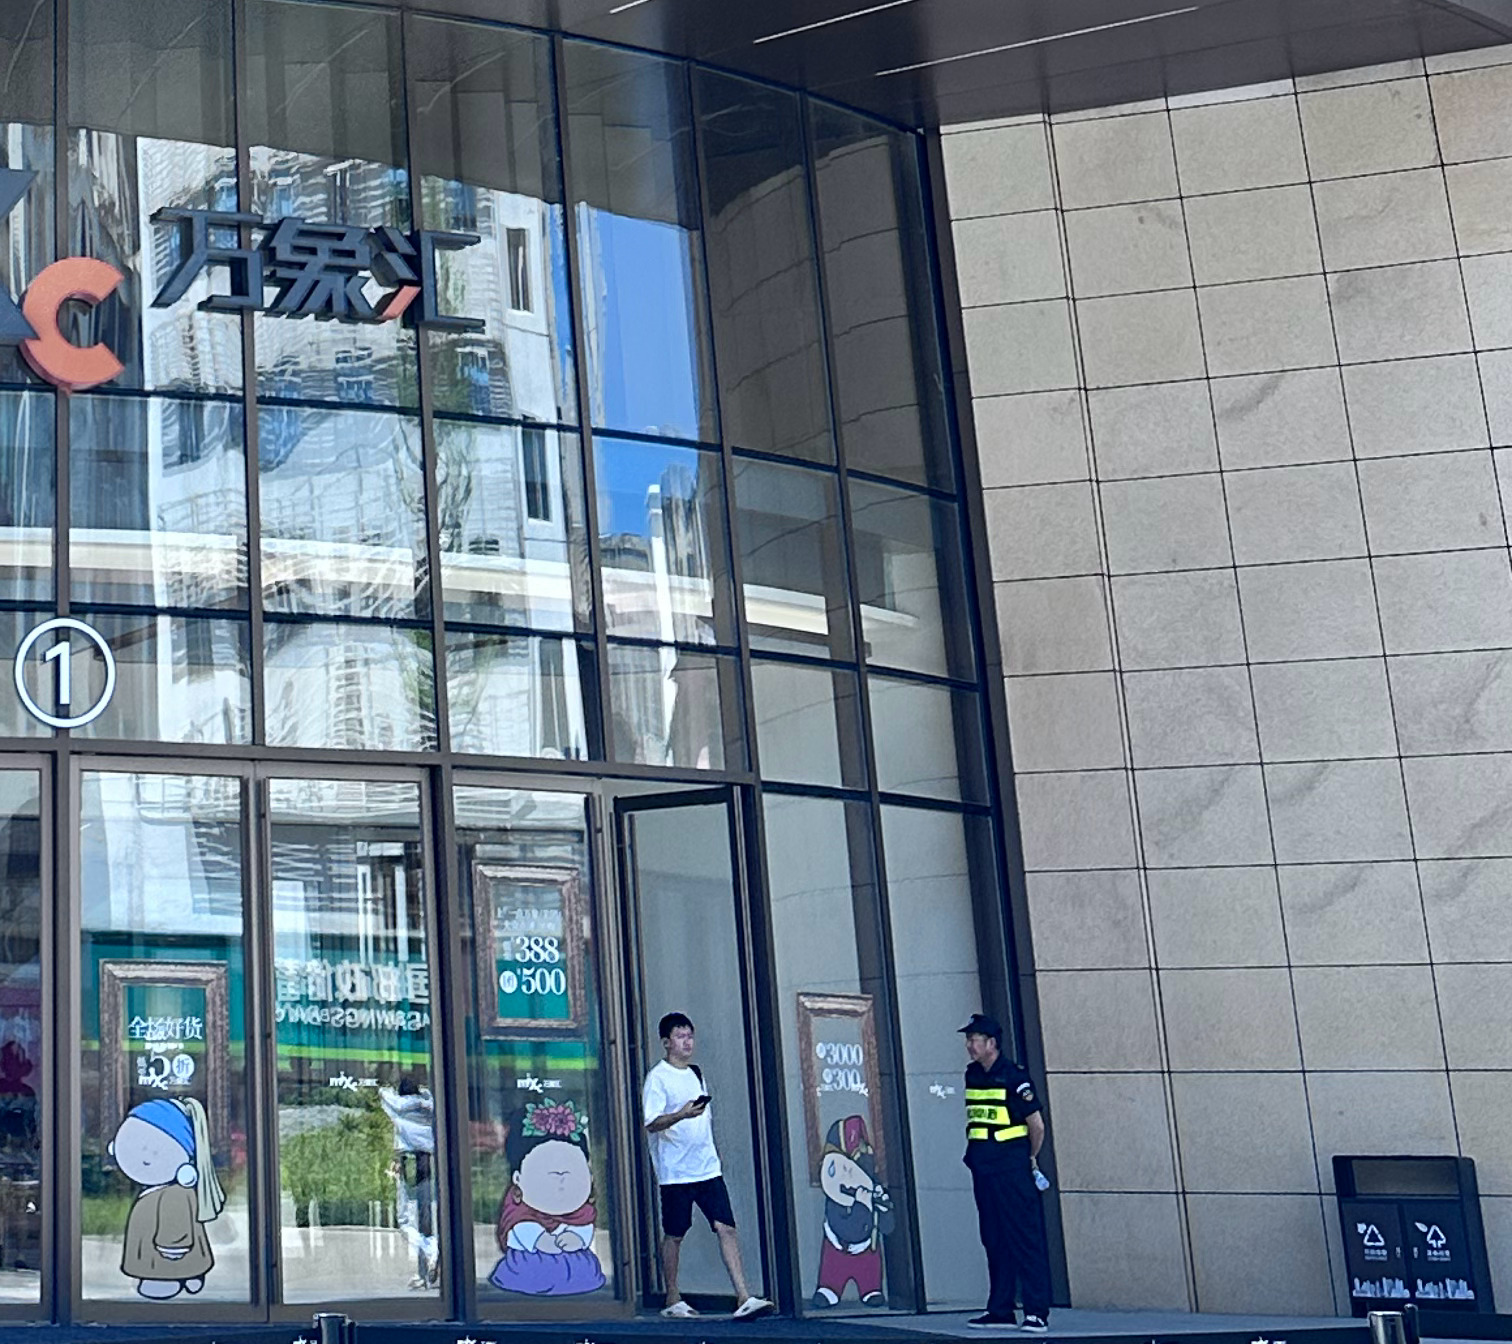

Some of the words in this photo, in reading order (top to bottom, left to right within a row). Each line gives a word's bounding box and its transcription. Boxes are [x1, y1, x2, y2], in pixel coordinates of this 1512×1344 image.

[149, 206, 485, 333] 万象汇
[515, 936, 560, 964] 388
[521, 967, 566, 996] 500
